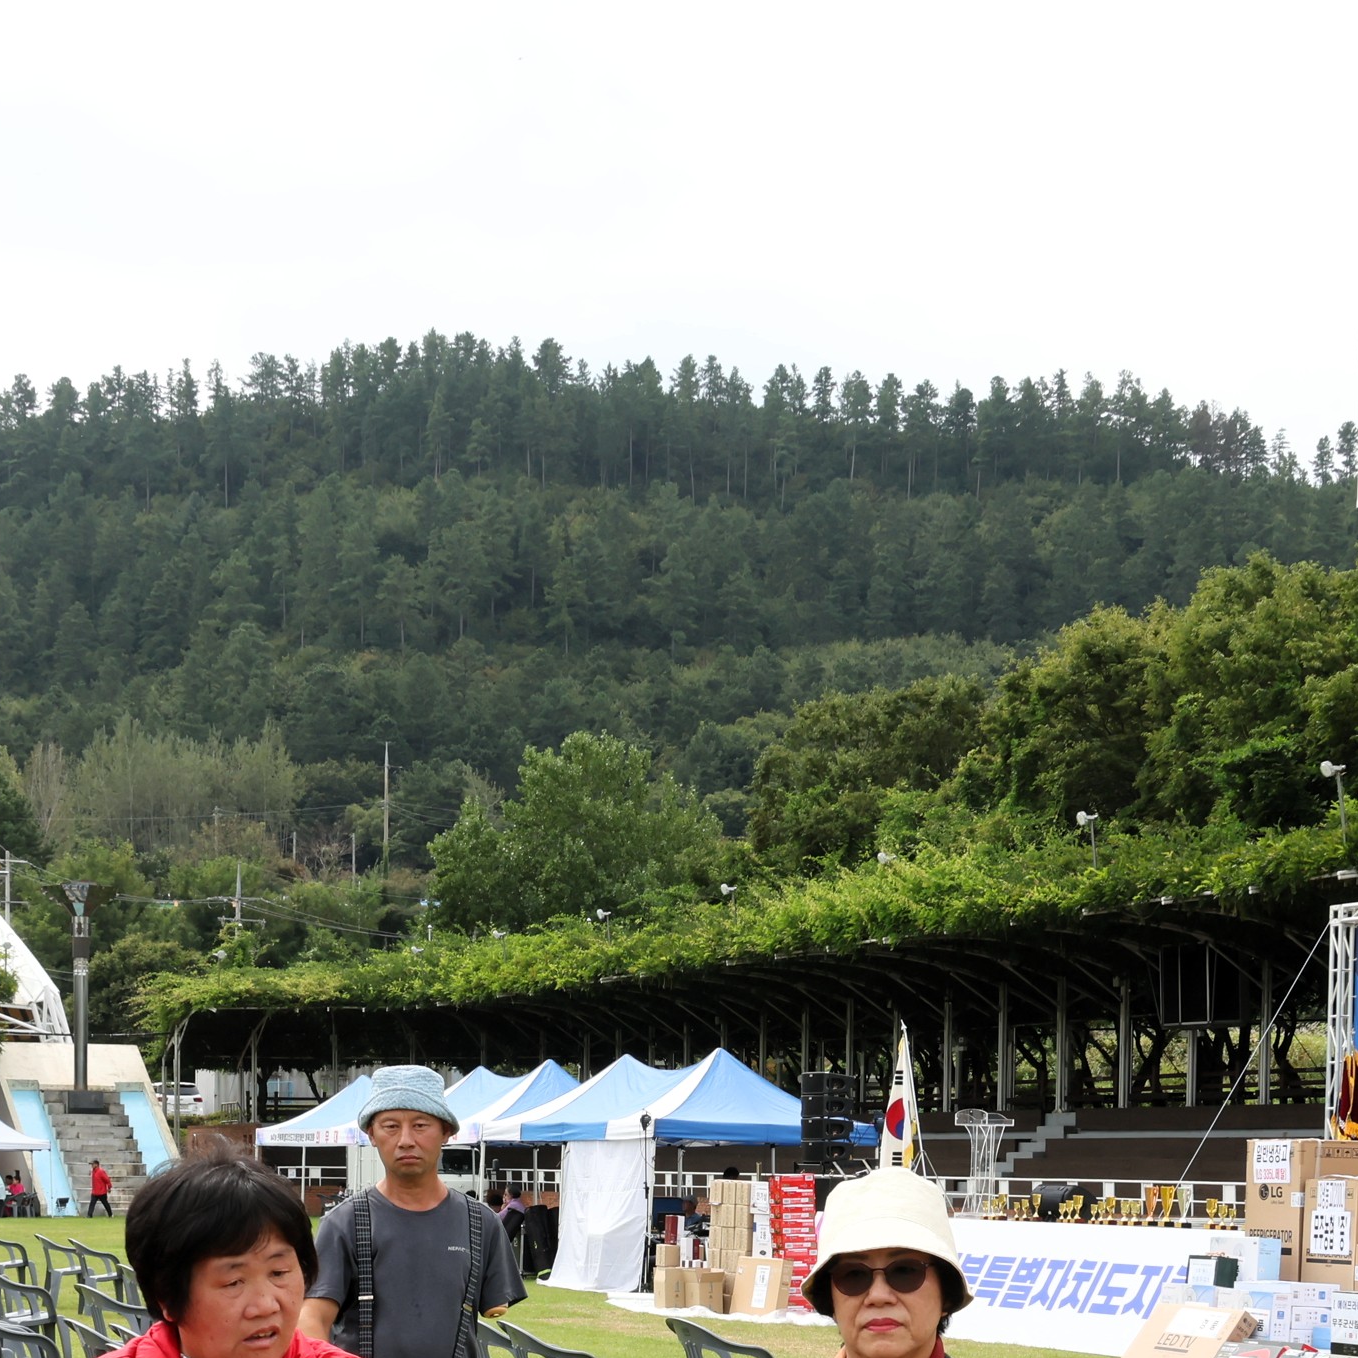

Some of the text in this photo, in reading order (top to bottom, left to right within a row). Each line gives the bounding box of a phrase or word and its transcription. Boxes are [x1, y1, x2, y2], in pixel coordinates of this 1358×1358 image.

[1256, 1144, 1288, 1163] 일반냉장고
[956, 1252, 1189, 1320] 북특별자치도지
[1157, 1332, 1198, 1349] LED TV
